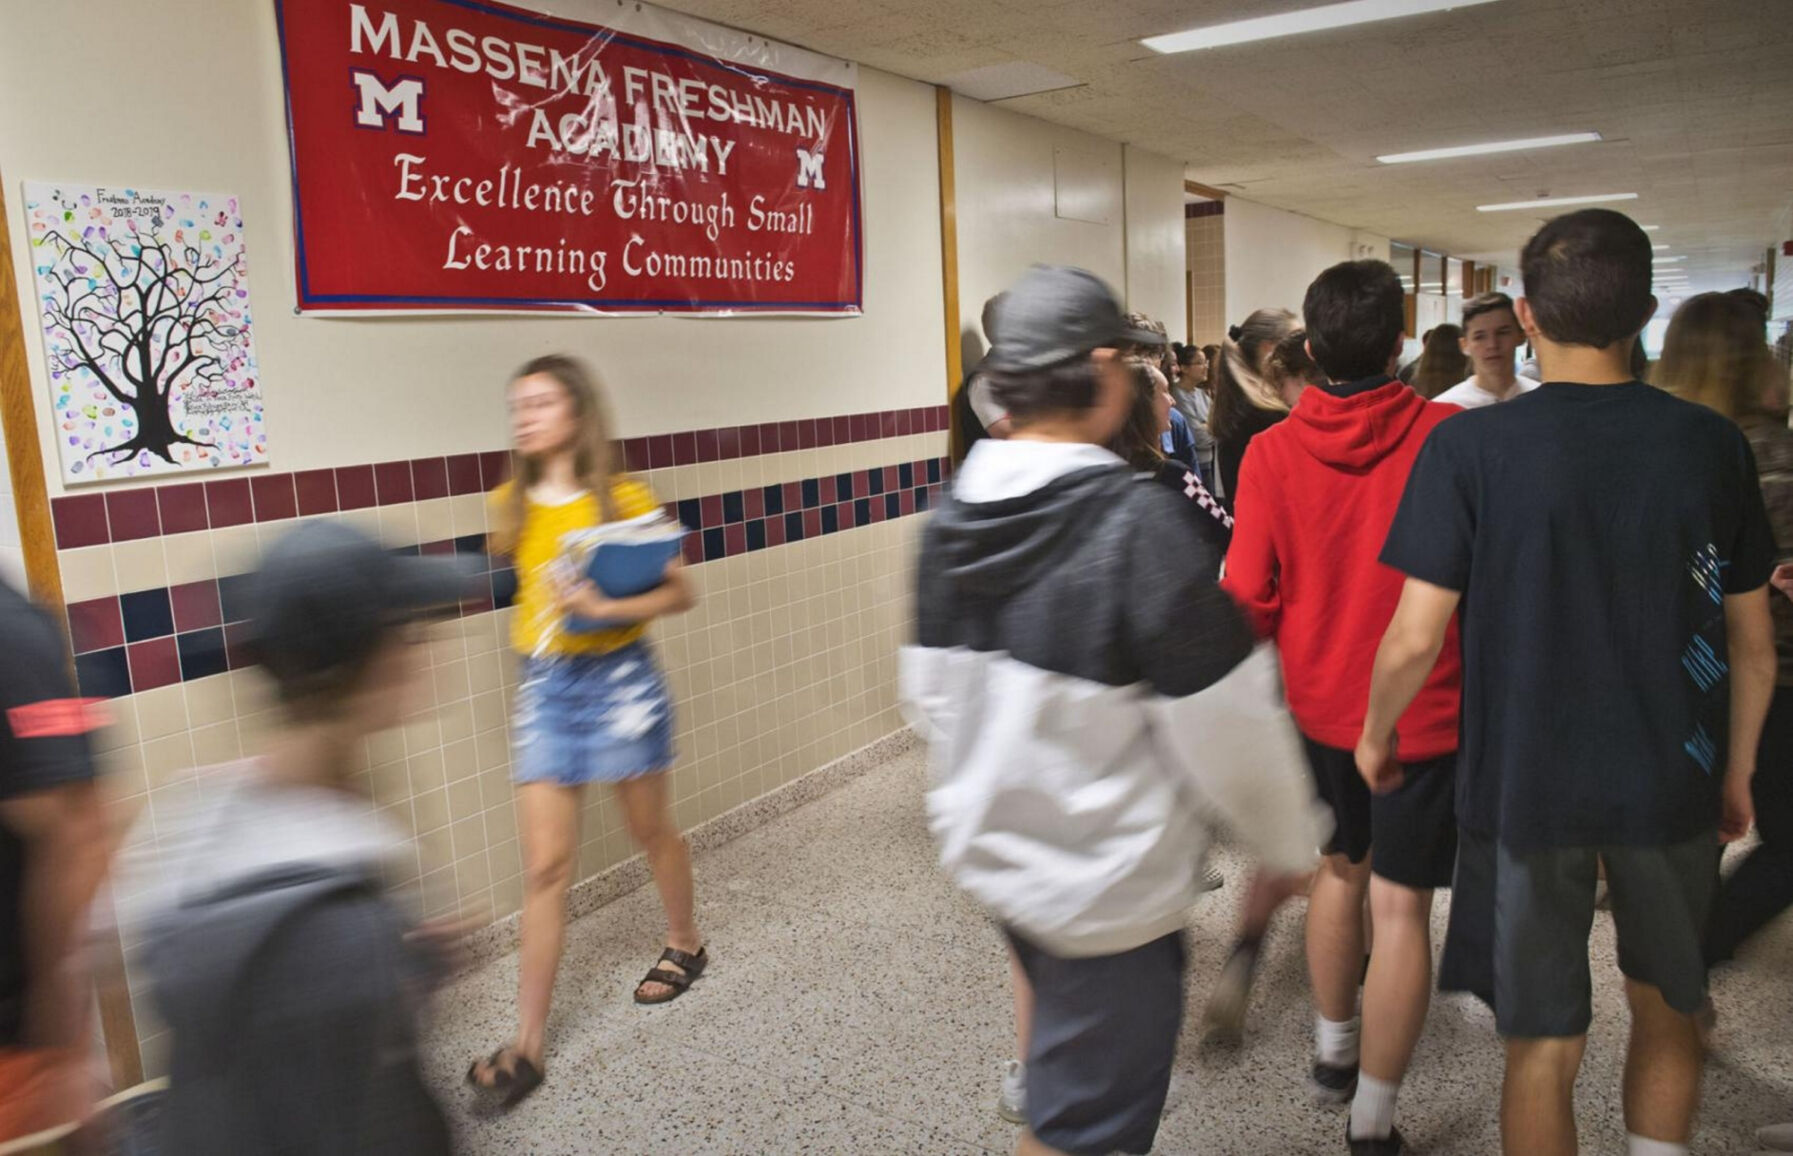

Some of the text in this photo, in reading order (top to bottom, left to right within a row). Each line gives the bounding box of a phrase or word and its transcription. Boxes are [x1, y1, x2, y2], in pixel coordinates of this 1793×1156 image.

[349, 3, 826, 139] MASSENA FRESHMAN
[352, 71, 424, 133] M
[525, 108, 736, 175] ACADEMY
[796, 148, 826, 190] M
[394, 152, 813, 241] Excellence Through Small
[442, 225, 795, 291] Learning Communities
